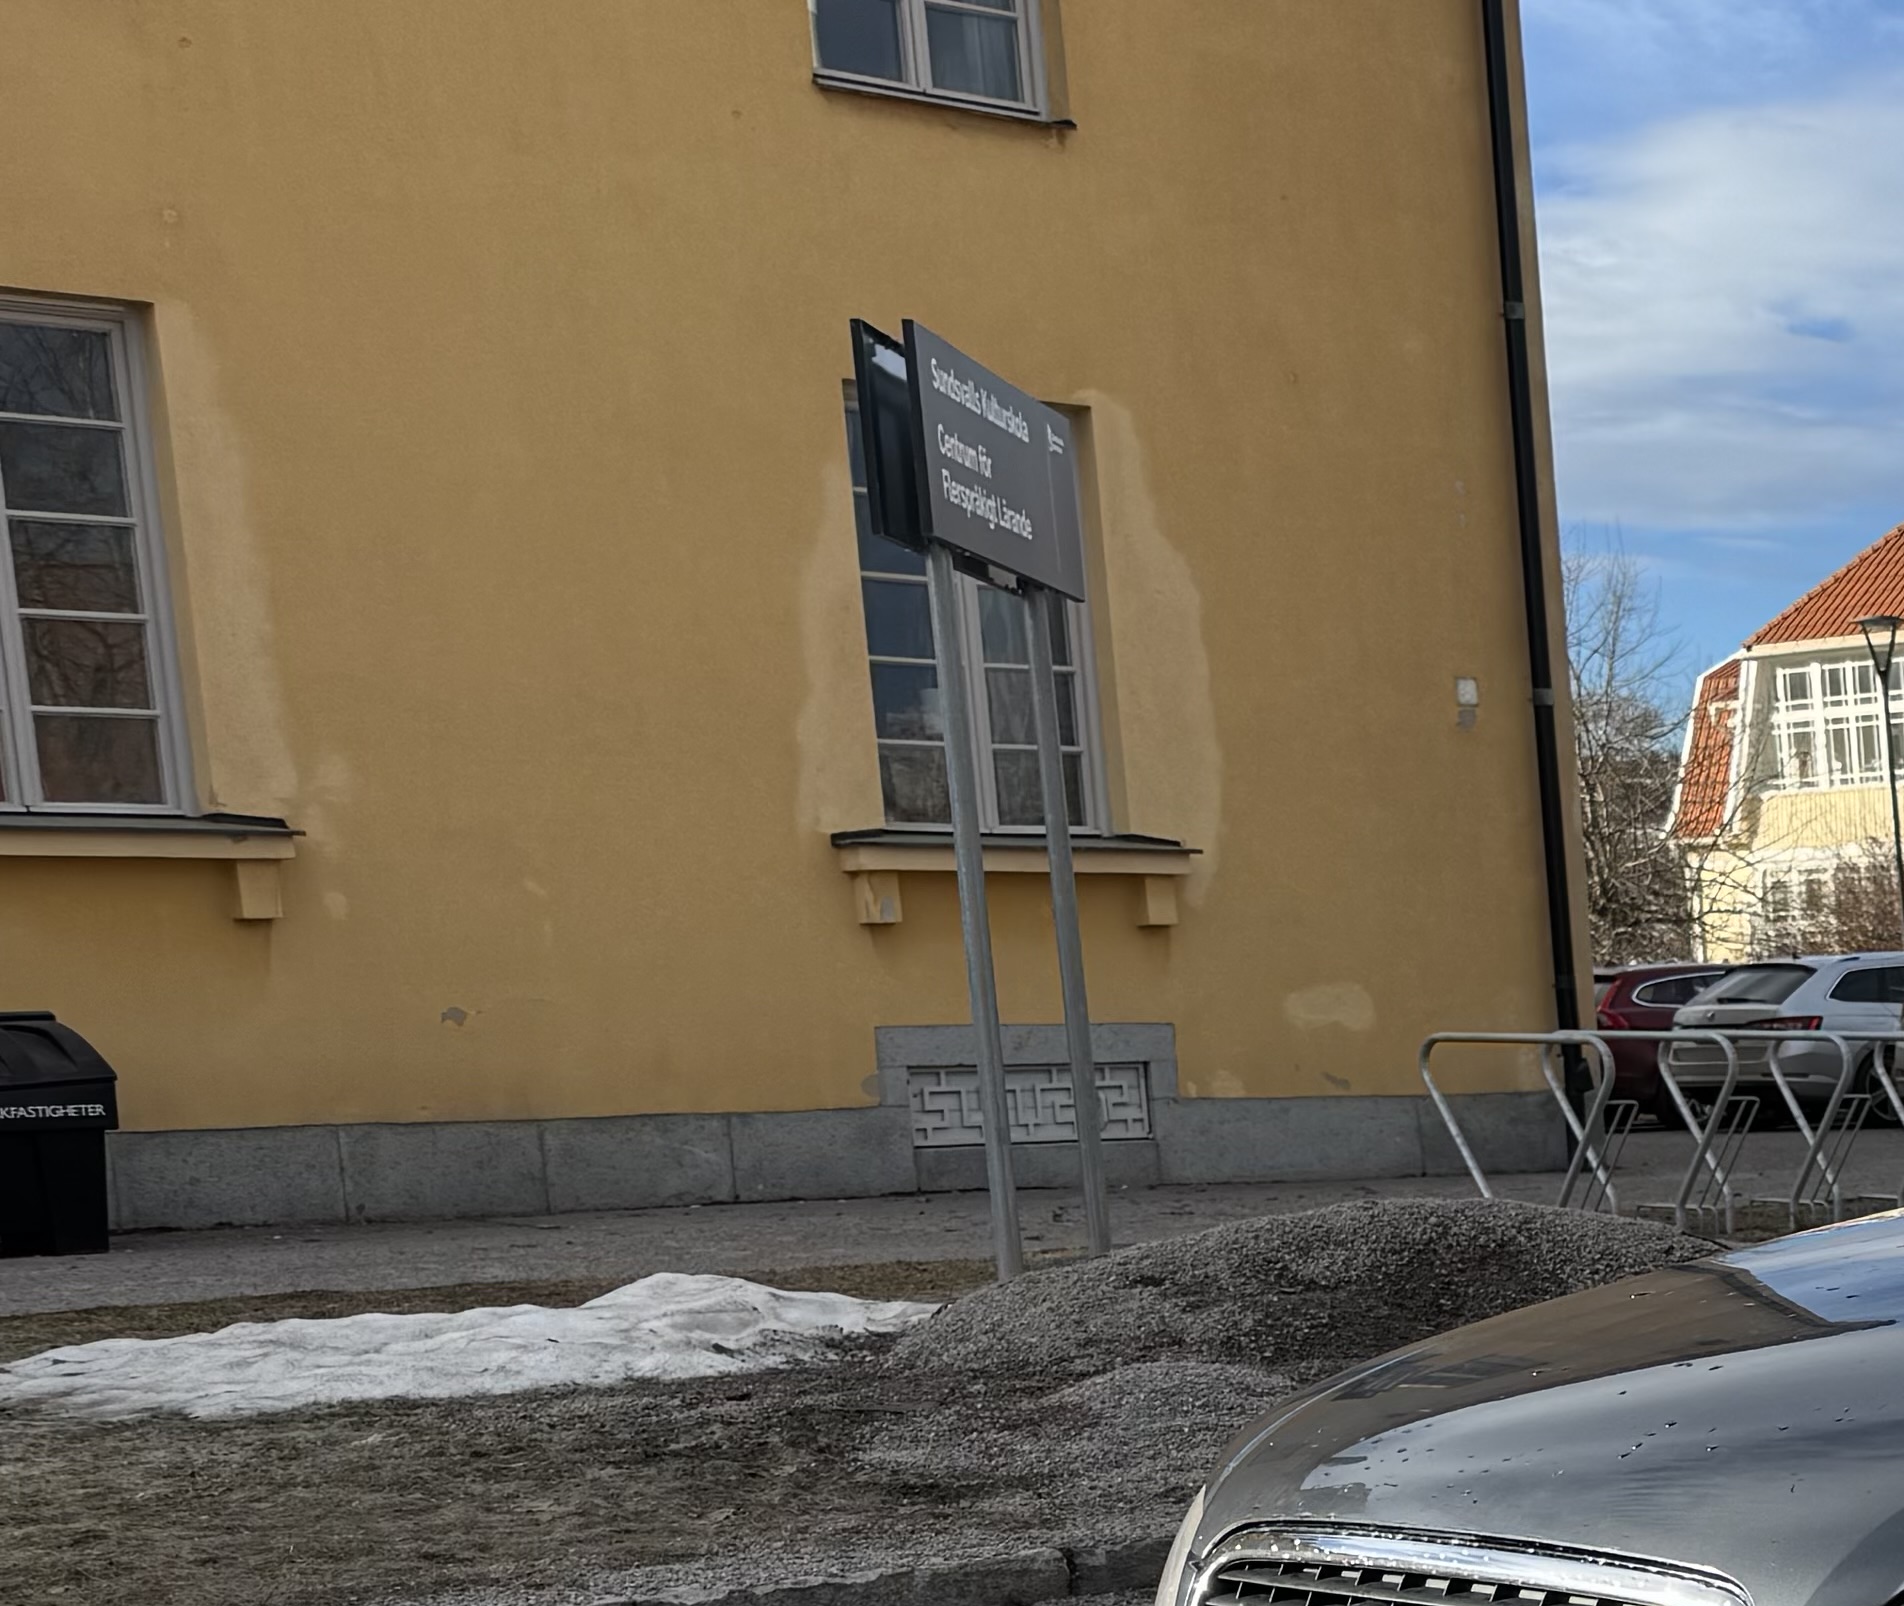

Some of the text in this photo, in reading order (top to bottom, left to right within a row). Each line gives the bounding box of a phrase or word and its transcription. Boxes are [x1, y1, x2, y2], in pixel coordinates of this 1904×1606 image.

[930, 357, 981, 415] Sundsvalls
[937, 423, 992, 479] Centrum för
[997, 497, 1033, 540] Lärande
